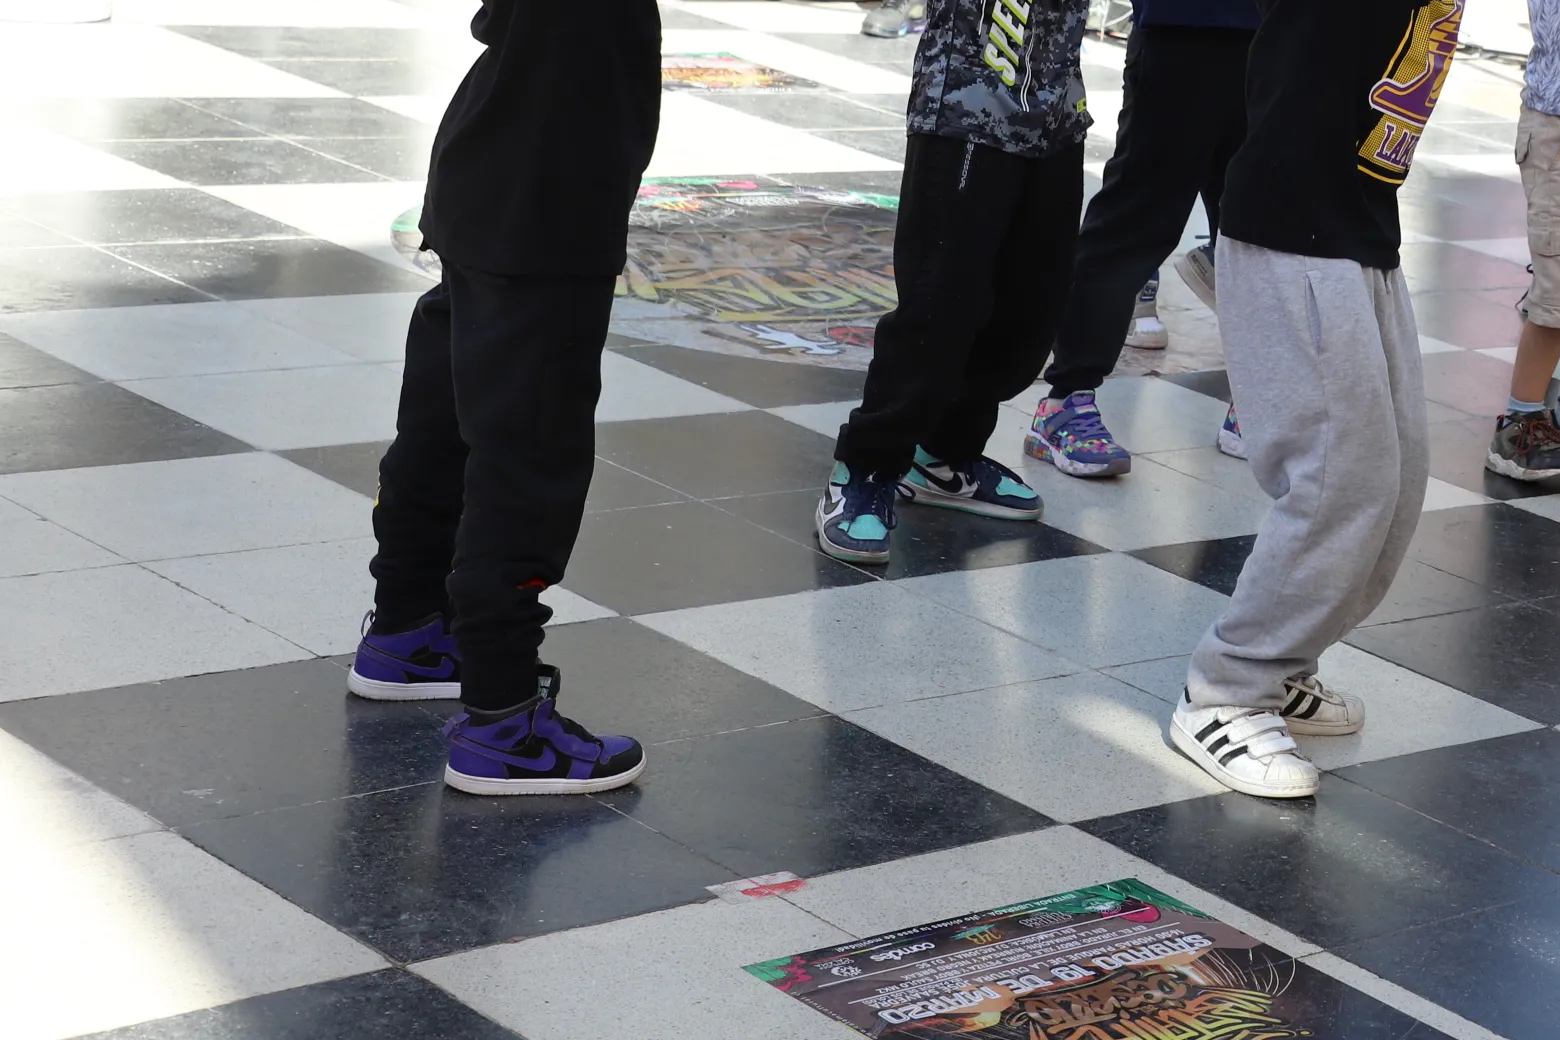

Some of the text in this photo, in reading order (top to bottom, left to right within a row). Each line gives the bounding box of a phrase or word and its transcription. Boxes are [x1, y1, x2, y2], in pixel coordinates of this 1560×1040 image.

[1035, 893, 1076, 905] ENTRADA
[988, 903, 1034, 916] LIBERADA
[931, 919, 963, 929] olvides
[896, 928, 920, 936] pase
[1055, 940, 1081, 949] BBOY
[1114, 935, 1156, 948] HORAS
[978, 947, 1025, 960] RUBREAK
[1065, 945, 1116, 960] PARQUE
[936, 959, 971, 970] NEGRO
[967, 959, 1003, 970] PETIZA
[1027, 961, 1049, 969] LA
[1046, 957, 1068, 965] DE
[880, 935, 1210, 1023] SÁBADO 19 DE MARZO
[900, 968, 937, 980] BREAK
[933, 969, 961, 979] BBOY
[972, 966, 1030, 983] CULTURA
[899, 976, 933, 987] SAULO
[875, 984, 900, 993] MKZ
[869, 988, 939, 1009] SAAVEDRA
